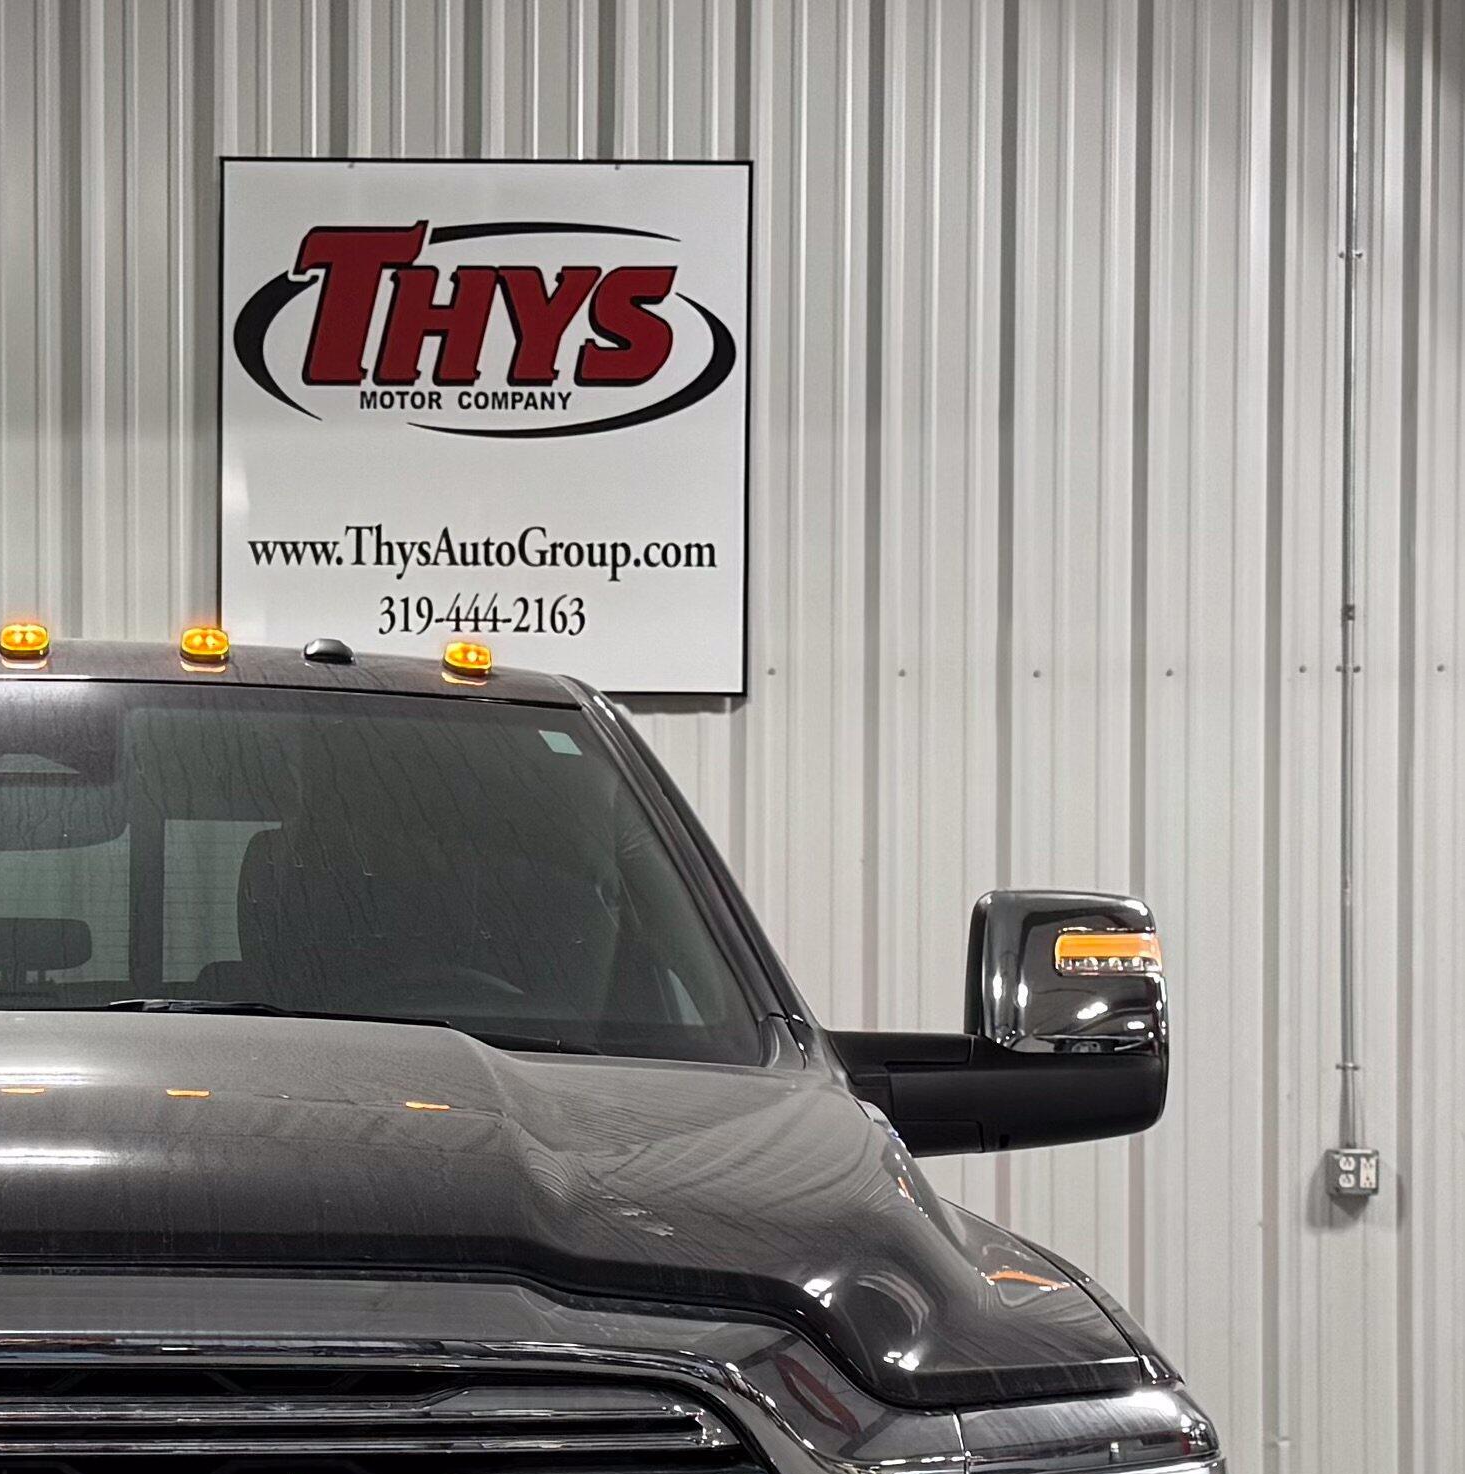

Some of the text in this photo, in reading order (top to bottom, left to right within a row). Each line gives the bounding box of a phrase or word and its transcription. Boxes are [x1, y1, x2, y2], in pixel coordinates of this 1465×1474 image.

[295, 219, 678, 387] THYS
[359, 391, 572, 411] MOTOR COMPANY
[247, 523, 717, 582] www.ThysAutoGroup.com
[378, 593, 586, 635] 319-444-2163
